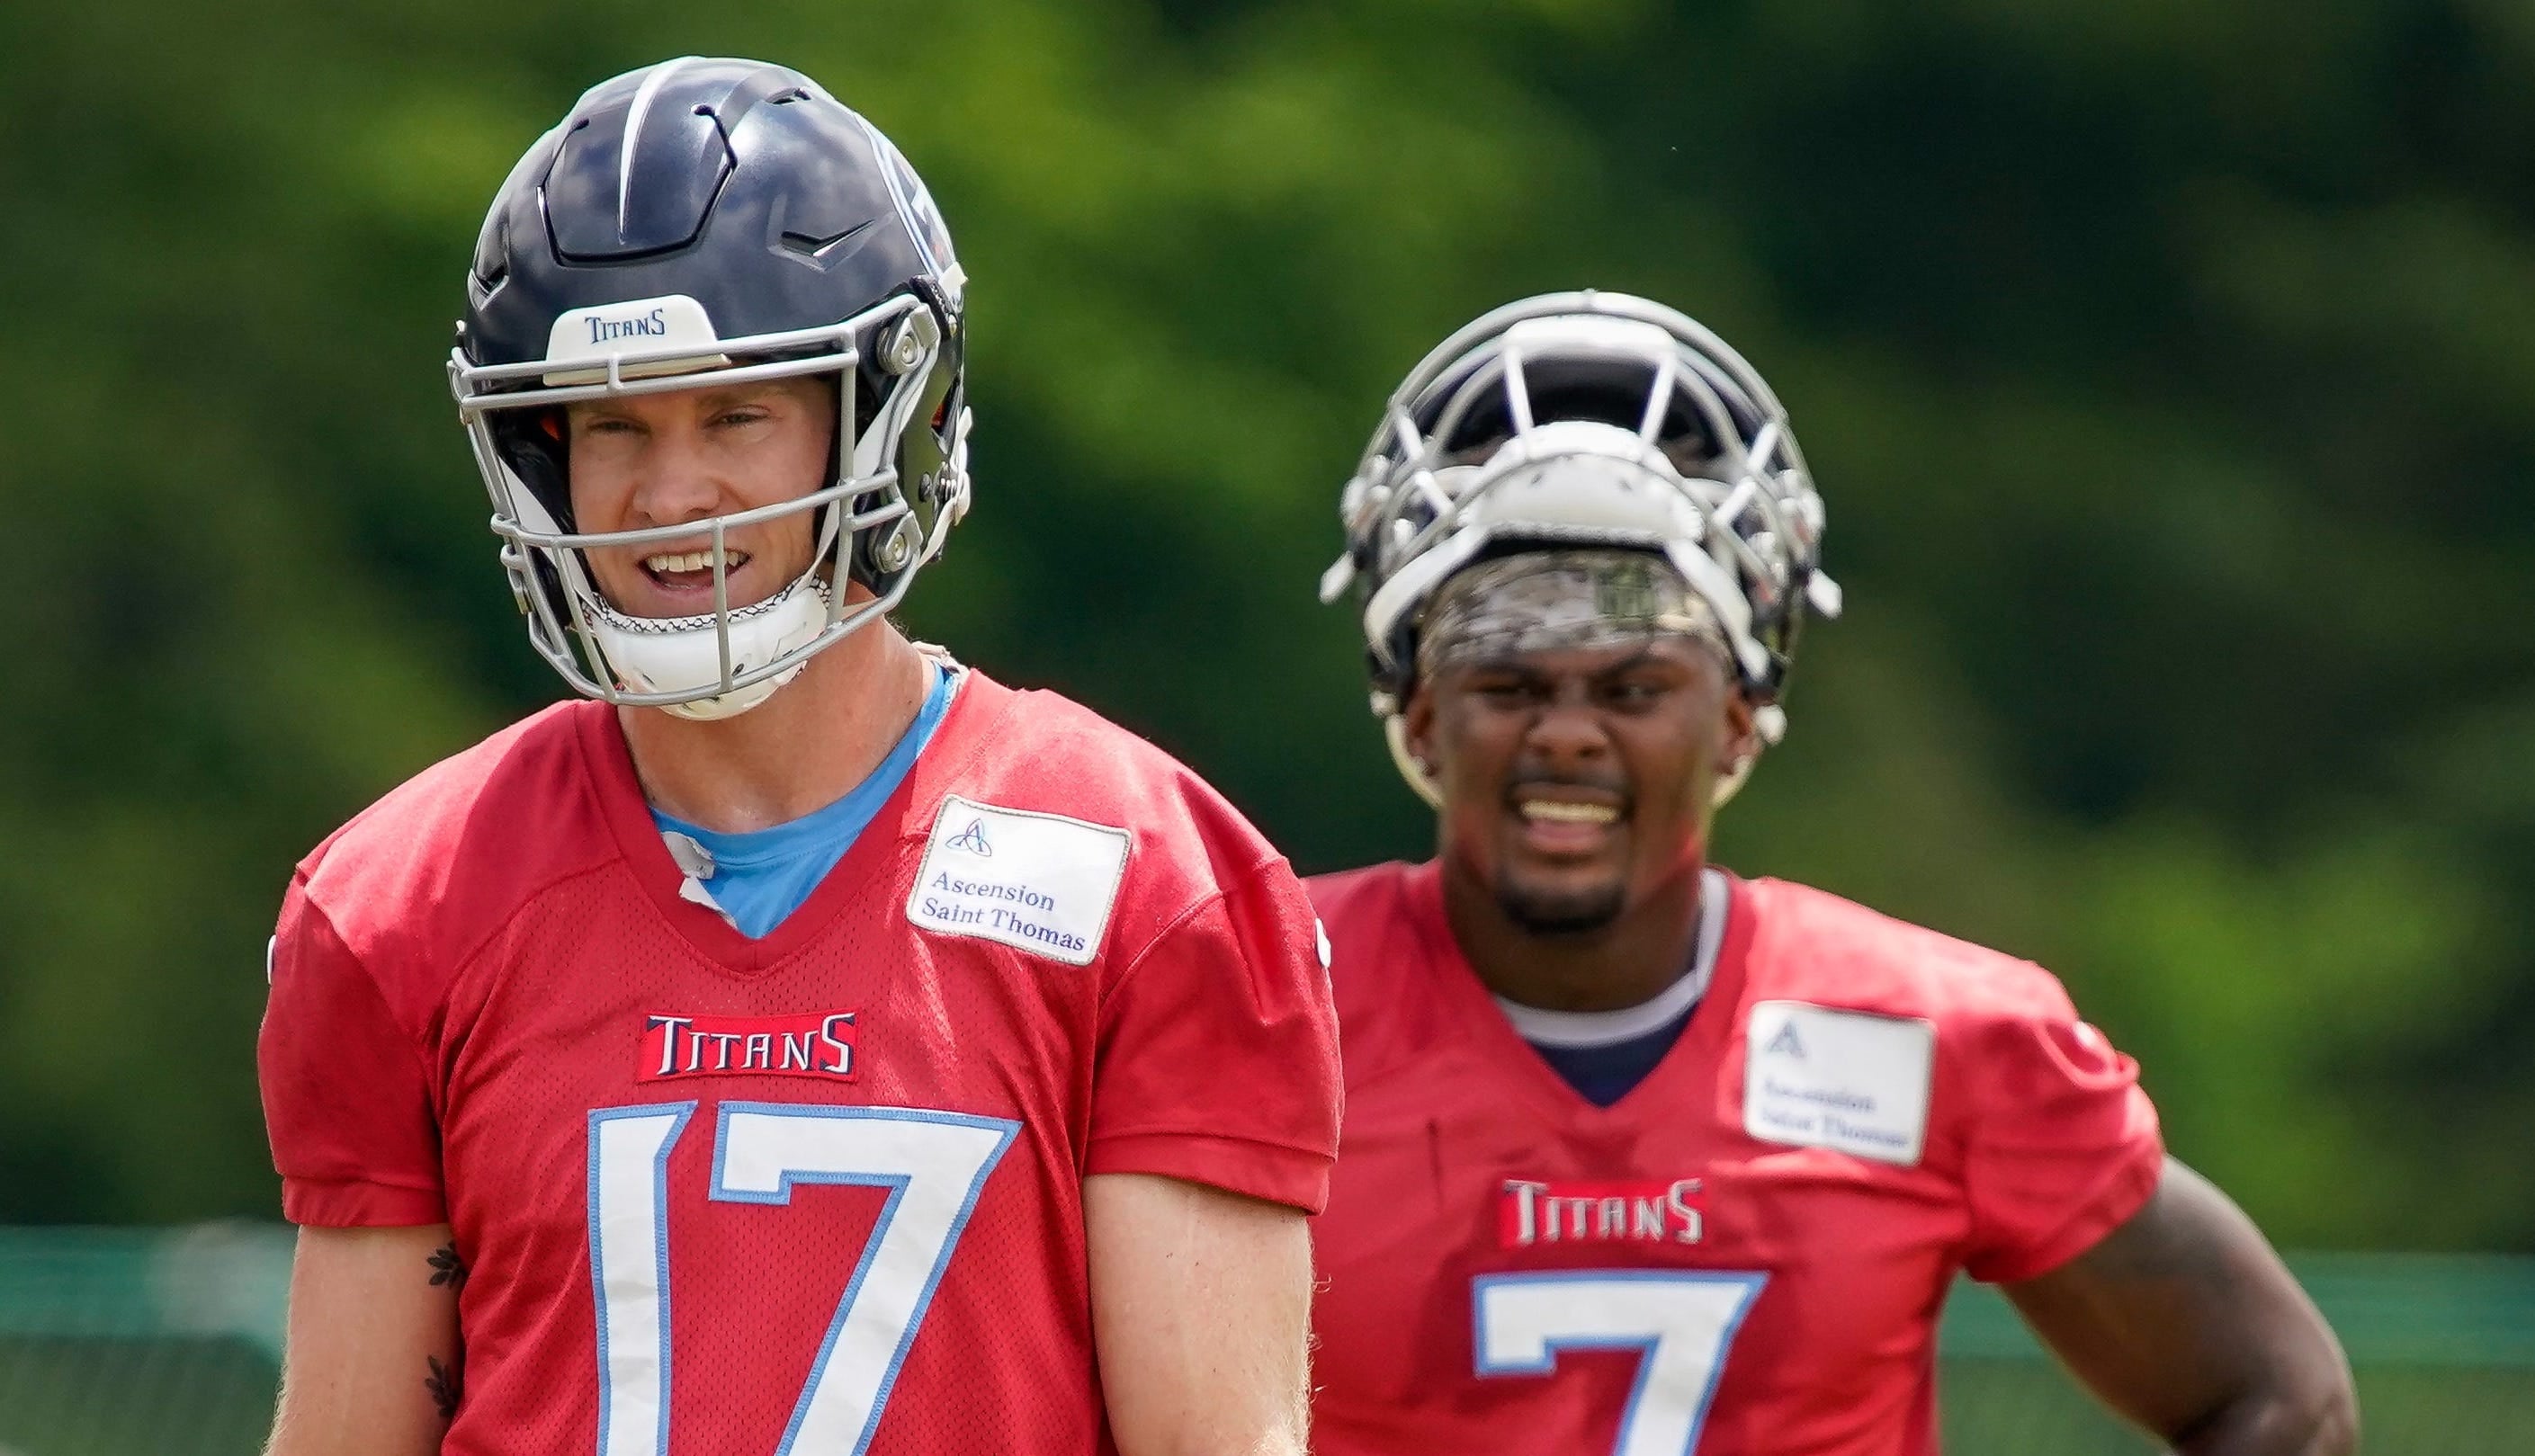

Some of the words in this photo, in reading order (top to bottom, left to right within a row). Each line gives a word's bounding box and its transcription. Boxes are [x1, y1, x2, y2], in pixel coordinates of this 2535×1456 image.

[585, 307, 666, 344] TITANS
[931, 871, 1056, 912] Ascension
[921, 897, 985, 925] Saint
[990, 907, 1087, 952] Thomas
[645, 1013, 856, 1076] TITANS
[1502, 1177, 1705, 1245] TITANS
[587, 1099, 1024, 1456] 17
[1471, 1268, 1771, 1456] 7
